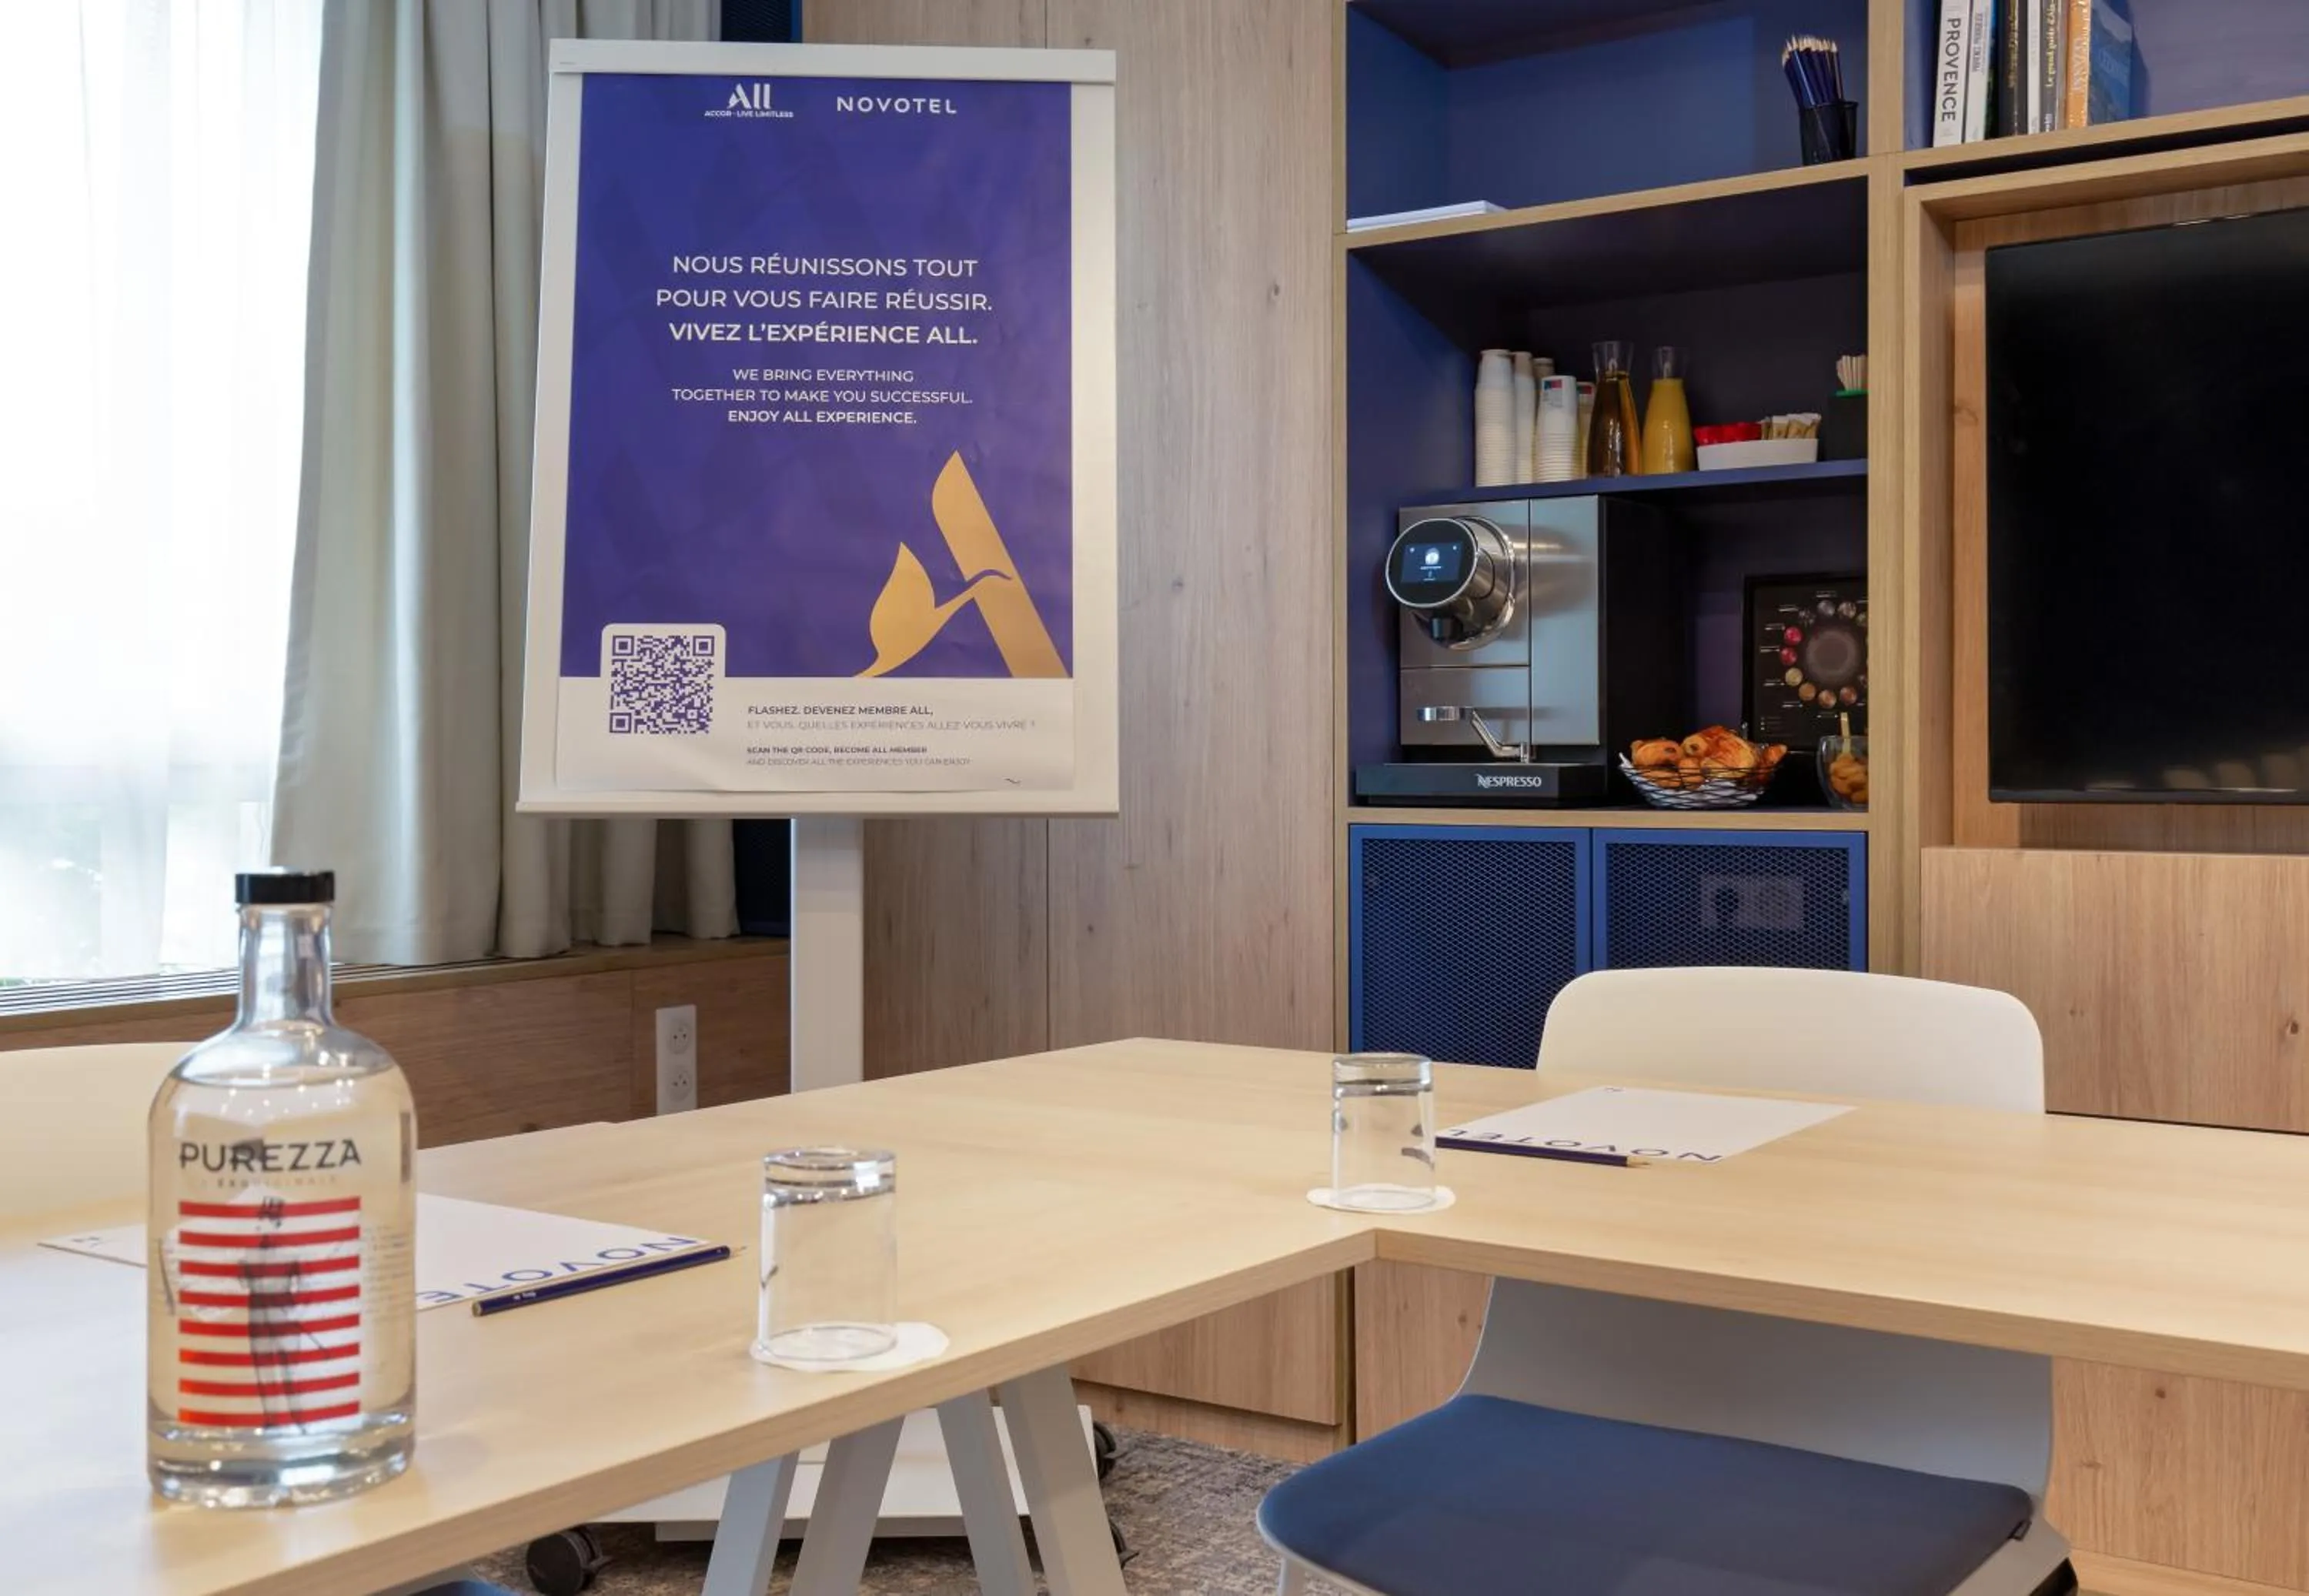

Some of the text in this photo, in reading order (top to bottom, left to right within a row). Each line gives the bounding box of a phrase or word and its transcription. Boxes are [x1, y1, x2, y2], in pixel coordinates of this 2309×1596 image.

[1941, 18, 1961, 122] PROVENCE
[837, 96, 957, 115] NOVOTEL
[673, 252, 978, 278] NOUS RÉUNISSONS TOUT
[657, 288, 992, 311] POUR VOUS FAIRE RÉUSSIR.
[669, 322, 741, 342] VIVEZ
[926, 326, 978, 344] ALL.
[732, 369, 914, 382] WE BRING EVERYTHING
[671, 389, 973, 404] TOGETHER TO MAKE YOU SUCCESSFUL.
[727, 409, 917, 425] ENJOY ALL EXPERIENCE.
[804, 706, 856, 715] DEVENEZ
[858, 706, 907, 715] MEMBRE
[910, 706, 934, 716] ALL,
[747, 720, 760, 730] ET
[797, 720, 848, 730] QUELLES
[995, 720, 1026, 730] VIVRE
[791, 746, 803, 755] QR
[805, 746, 832, 756] CODE,
[905, 758, 923, 766] YOU
[1474, 773, 1542, 788] NESPRESSO
[1449, 1128, 1723, 1160] NOVOTEL
[179, 1139, 361, 1172] PUREZZA
[415, 1237, 697, 1304] NOVOTE
